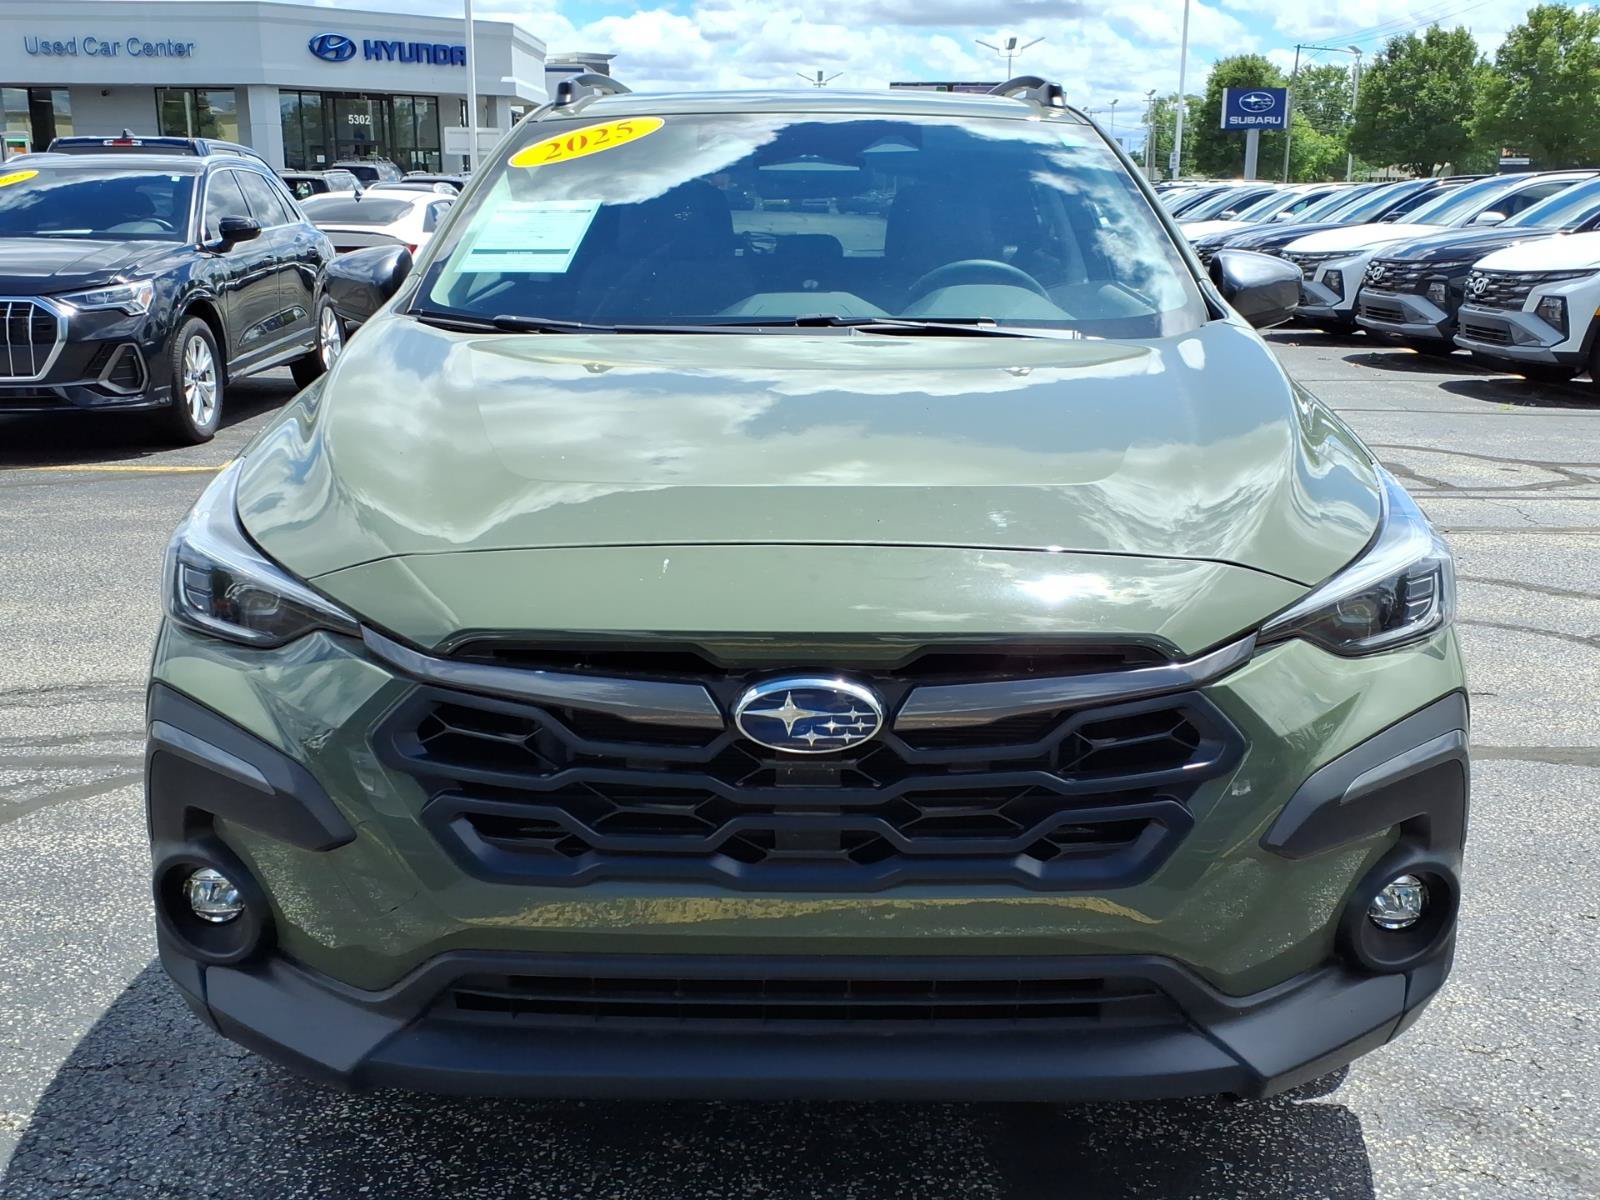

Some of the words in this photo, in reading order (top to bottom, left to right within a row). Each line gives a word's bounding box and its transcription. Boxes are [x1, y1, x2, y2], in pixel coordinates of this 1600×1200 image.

[24, 36, 78, 56] Used
[83, 36, 121, 57] Car
[126, 37, 195, 57] Center
[363, 39, 467, 66] HYUNDA
[348, 114, 371, 125] 5302
[1229, 116, 1281, 124] SUBARU
[544, 121, 633, 160] 2025
